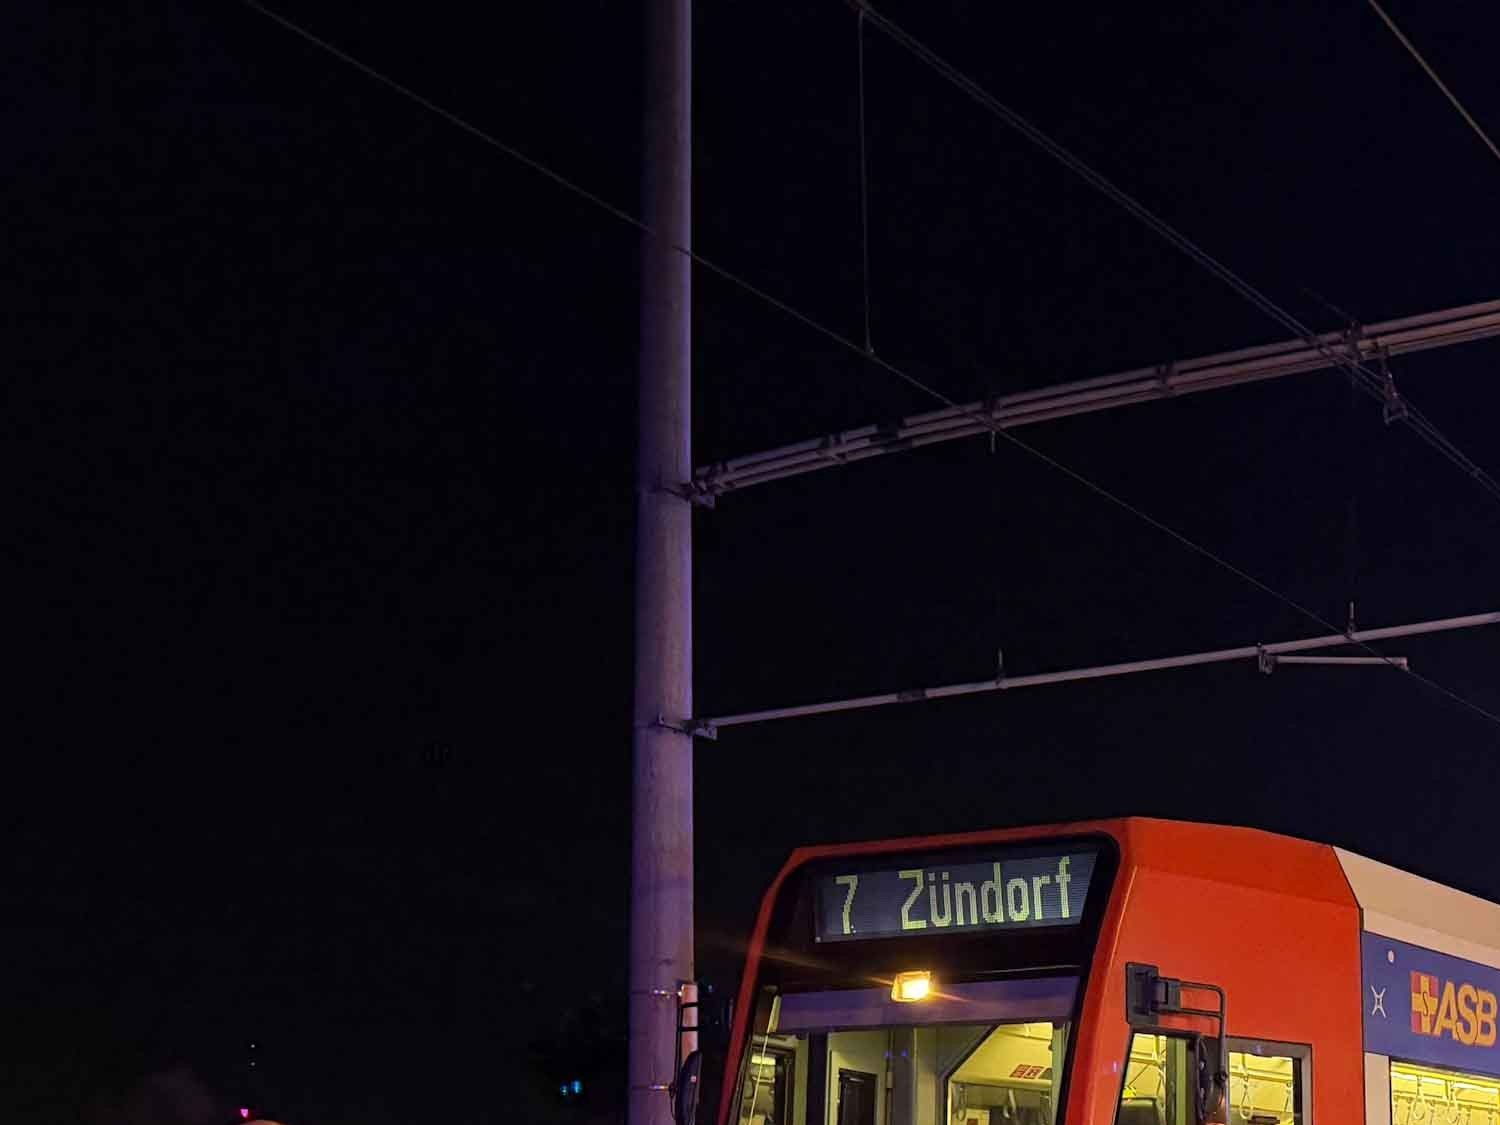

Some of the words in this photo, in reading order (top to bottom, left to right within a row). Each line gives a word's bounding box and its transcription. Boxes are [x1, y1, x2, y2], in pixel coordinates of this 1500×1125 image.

[834, 875, 859, 934] 7
[898, 856, 1071, 930] Zündorf
[1433, 980, 1498, 1047] ASB
